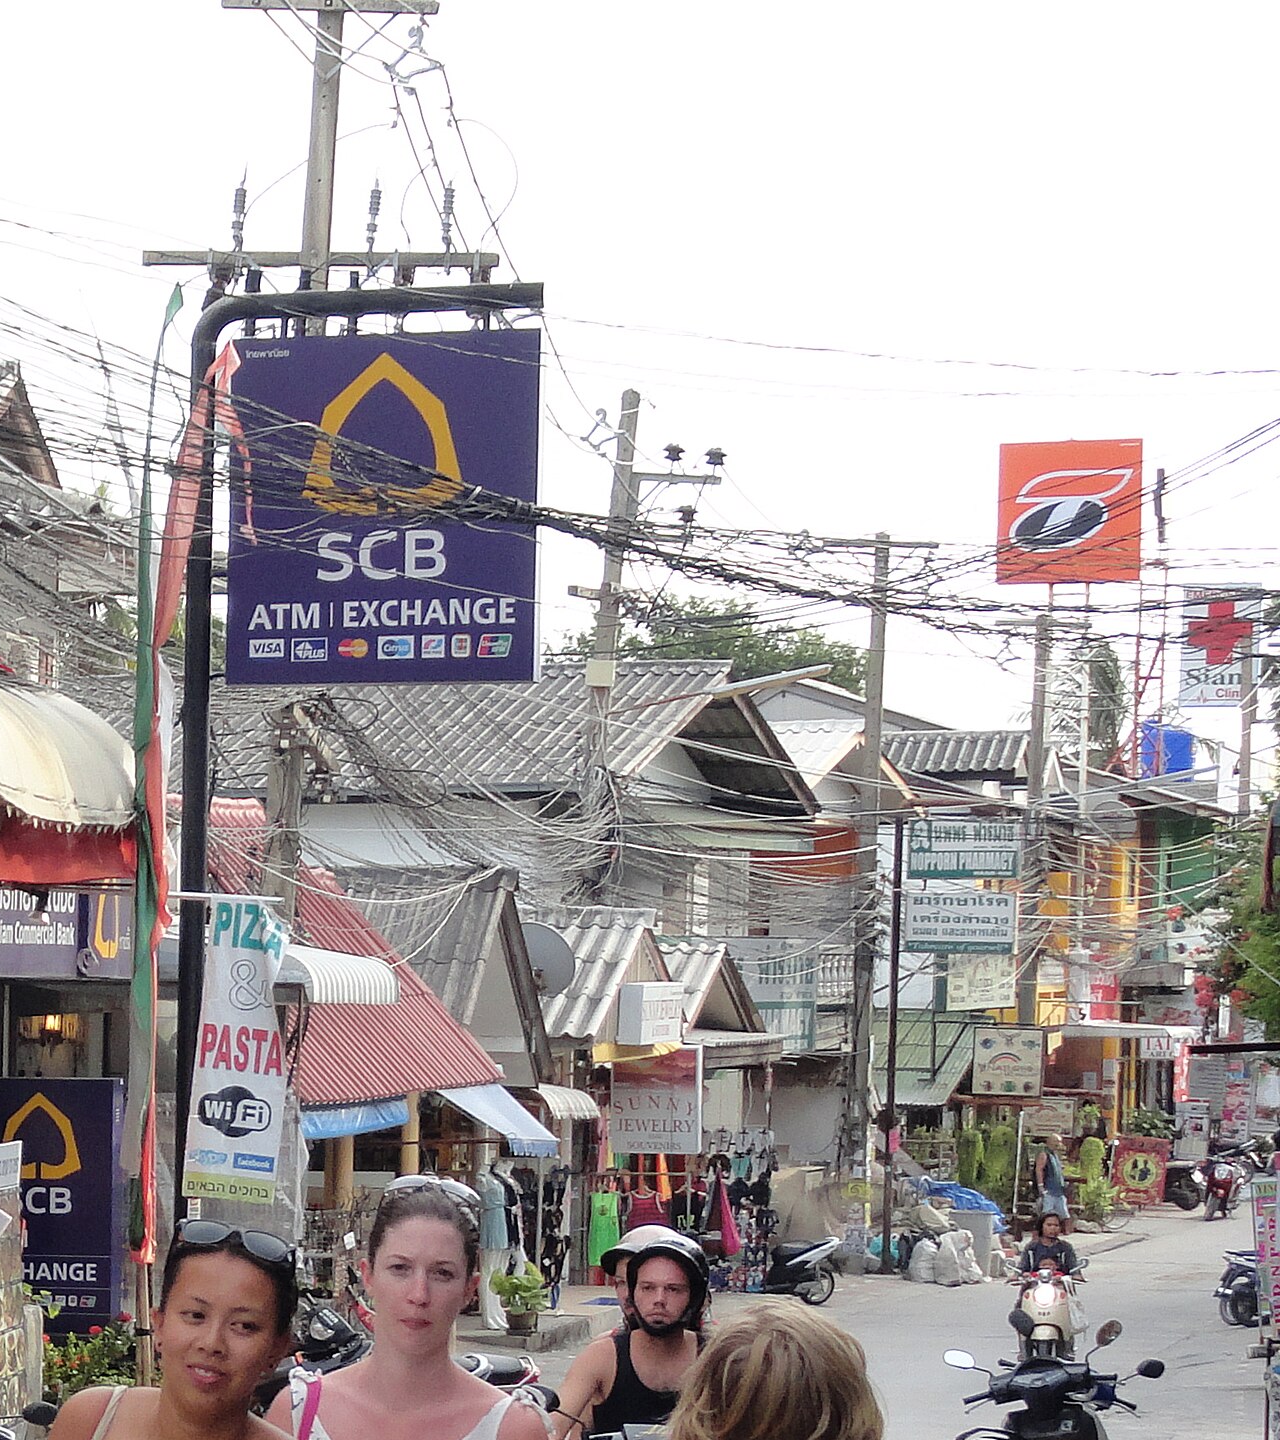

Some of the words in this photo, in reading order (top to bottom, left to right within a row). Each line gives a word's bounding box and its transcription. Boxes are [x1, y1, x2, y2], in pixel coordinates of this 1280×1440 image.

[316, 530, 447, 582] SCB
[247, 602, 321, 630] ATM
[343, 597, 517, 628] EXCHANGE
[252, 643, 282, 654] VISA
[959, 852, 1016, 870] PHARMACY
[14, 921, 55, 945] Commercial
[56, 922, 75, 946] Bank
[229, 959, 273, 1011] &
[198, 1023, 283, 1077] PASTA
[617, 1118, 695, 1133] JEWELRY
[187, 1181, 225, 1192] הבאים
[229, 1185, 269, 1198] ברוכים
[20, 1187, 73, 1215] CB
[22, 1262, 98, 1282] HANGE
